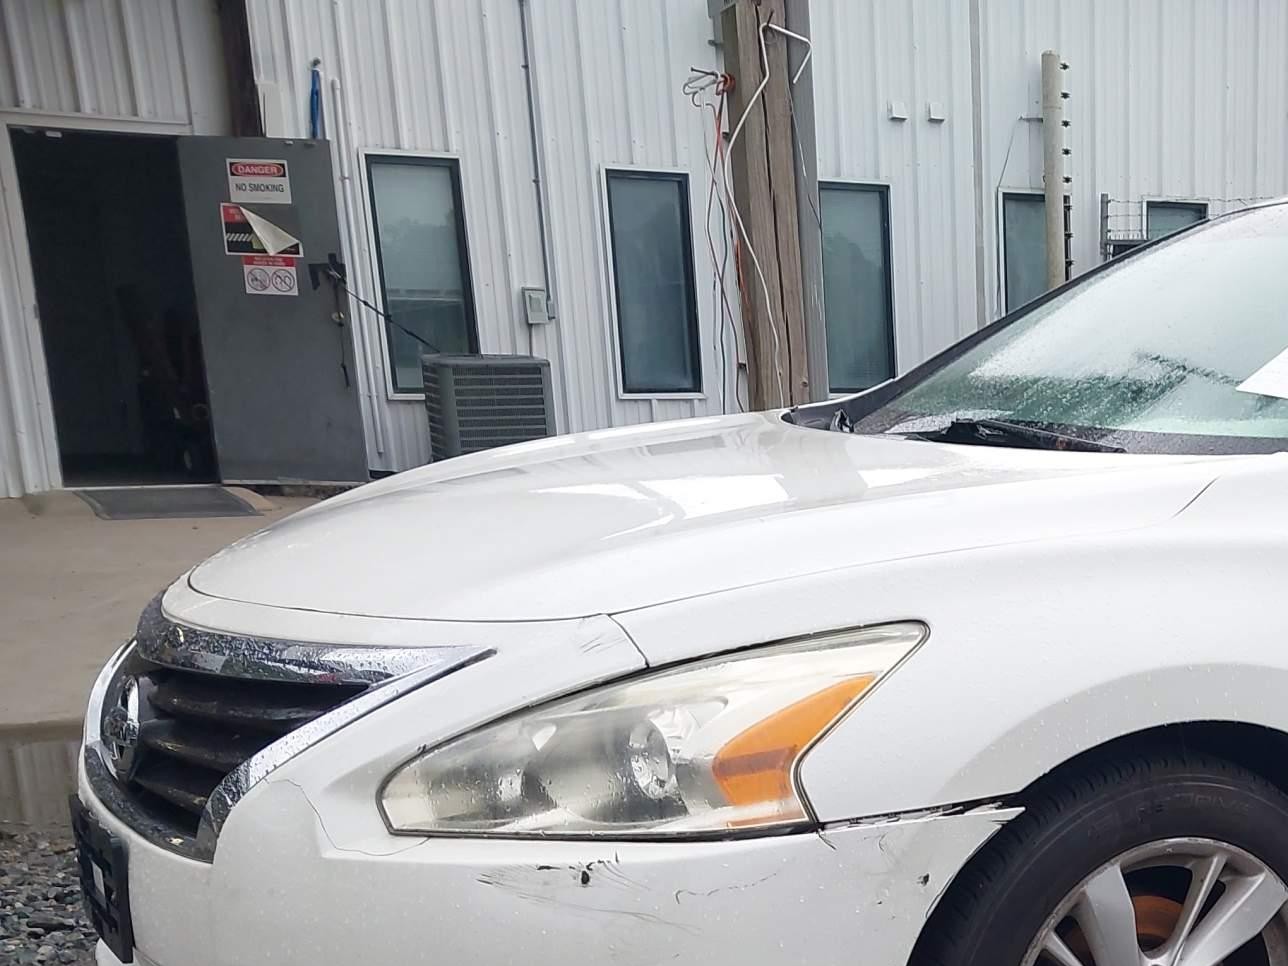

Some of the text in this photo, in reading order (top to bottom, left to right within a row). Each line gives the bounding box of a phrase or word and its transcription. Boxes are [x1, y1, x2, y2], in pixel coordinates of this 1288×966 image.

[237, 164, 278, 174] DANGER
[235, 183, 284, 193] NO SMOKING
